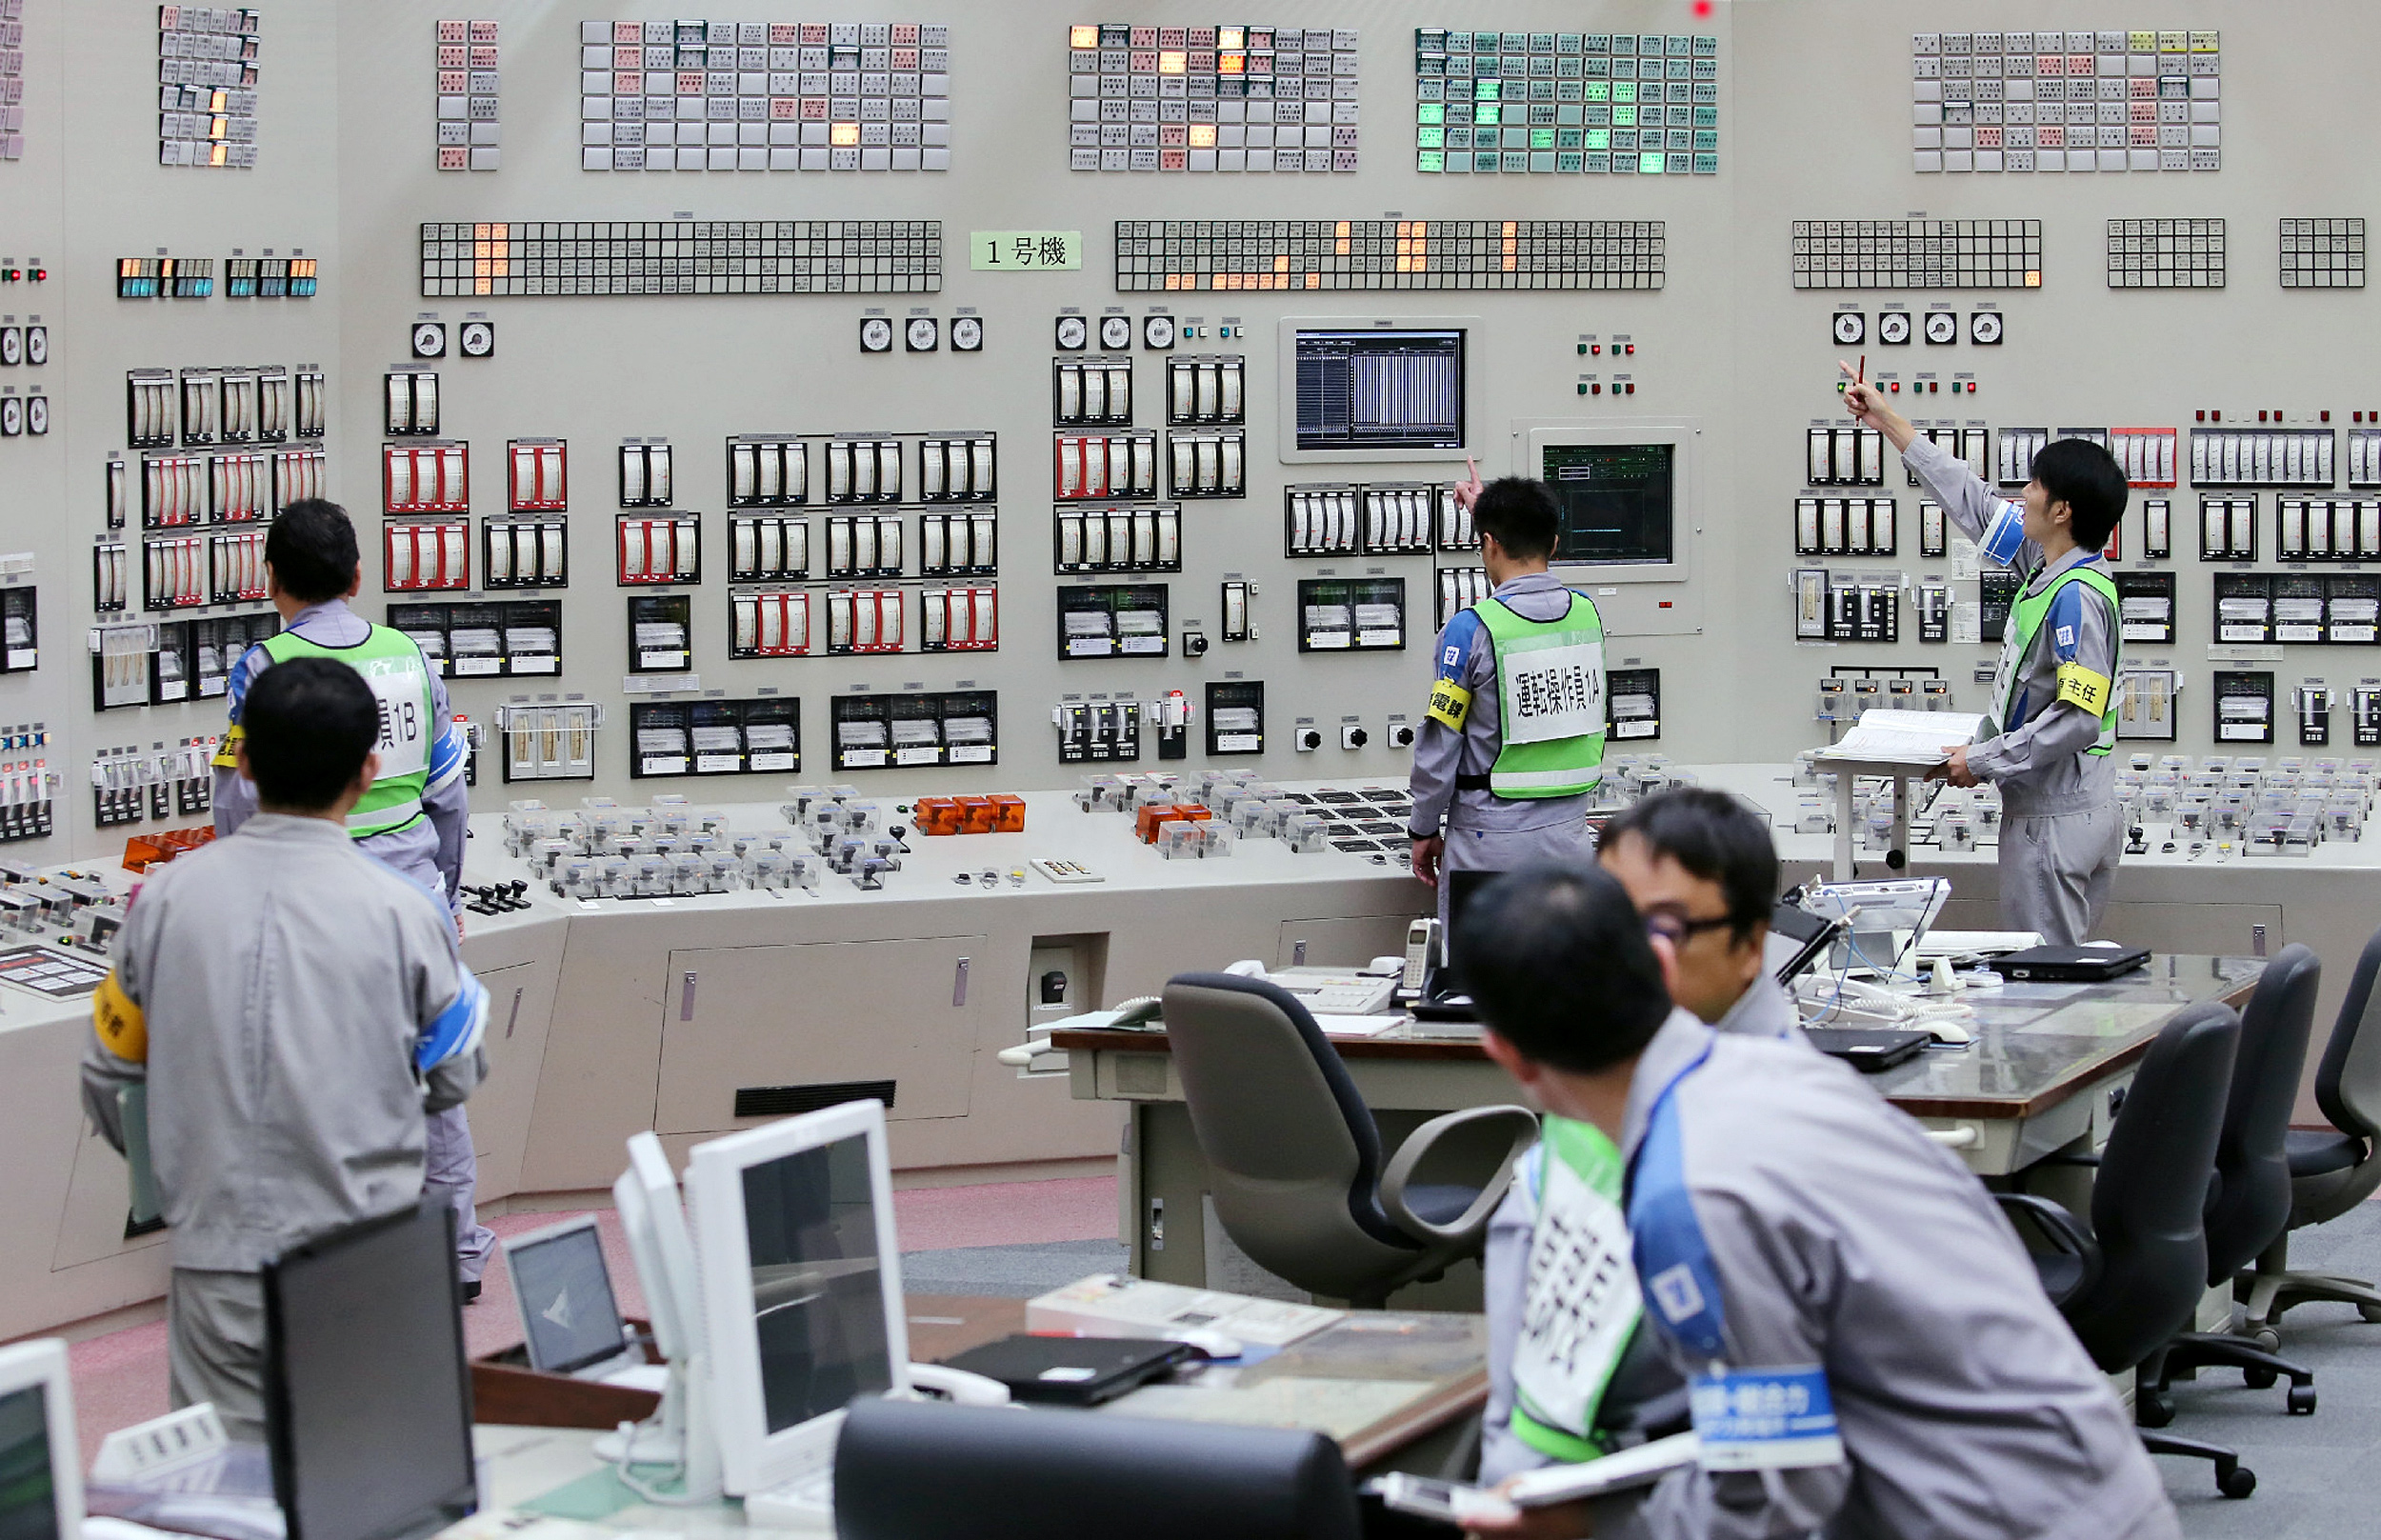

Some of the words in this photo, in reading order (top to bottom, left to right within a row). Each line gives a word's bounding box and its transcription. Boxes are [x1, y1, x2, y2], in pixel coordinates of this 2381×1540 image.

[1515, 665, 1601, 717] 運転操作員1A
